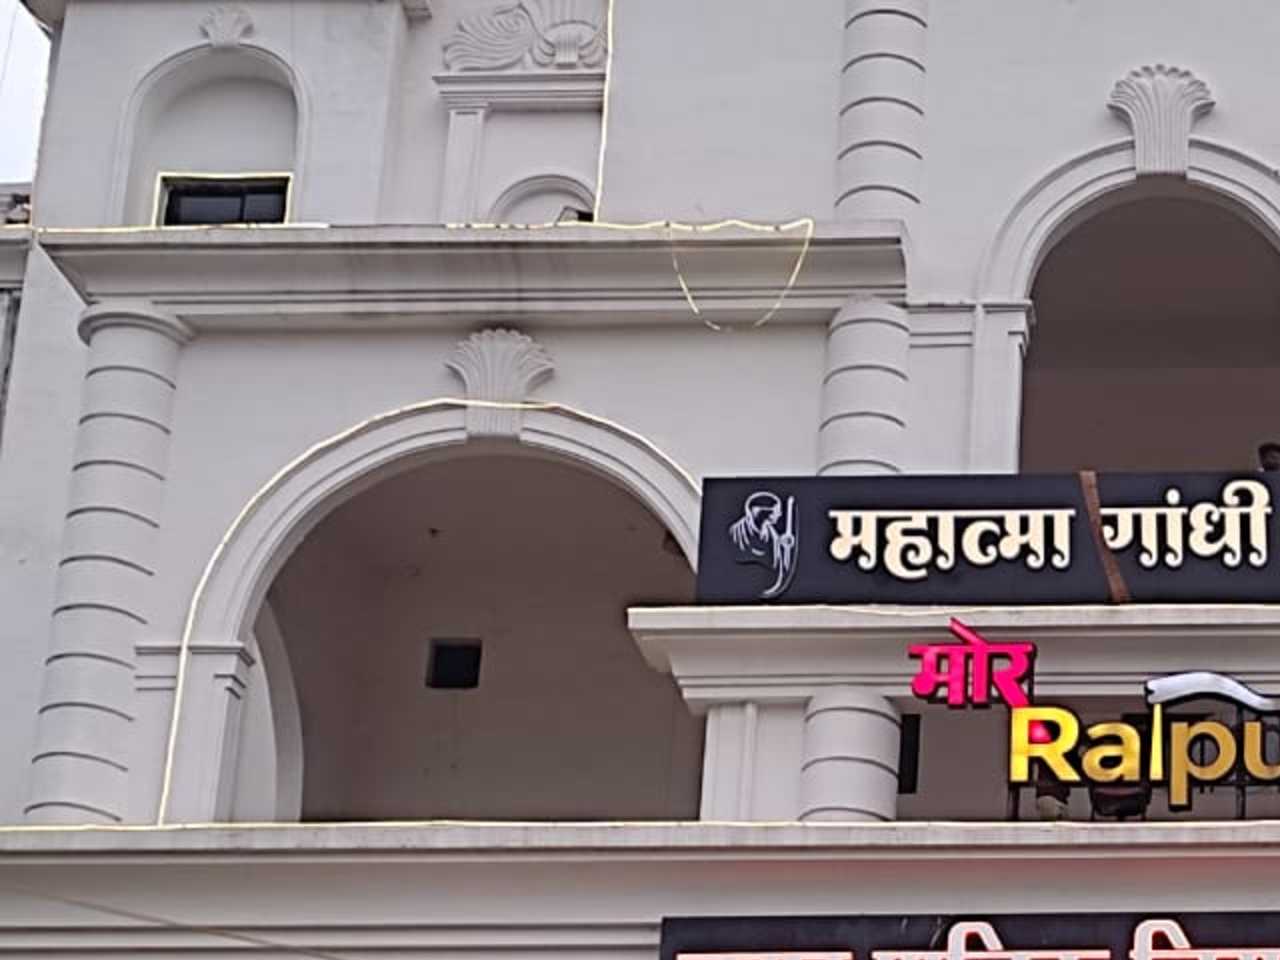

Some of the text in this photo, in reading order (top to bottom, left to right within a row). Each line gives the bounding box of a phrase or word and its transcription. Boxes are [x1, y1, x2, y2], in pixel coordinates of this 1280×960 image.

[828, 507, 1076, 580] महात्मा
[1099, 479, 1273, 567] गांधी
[907, 617, 1035, 708] मोर
